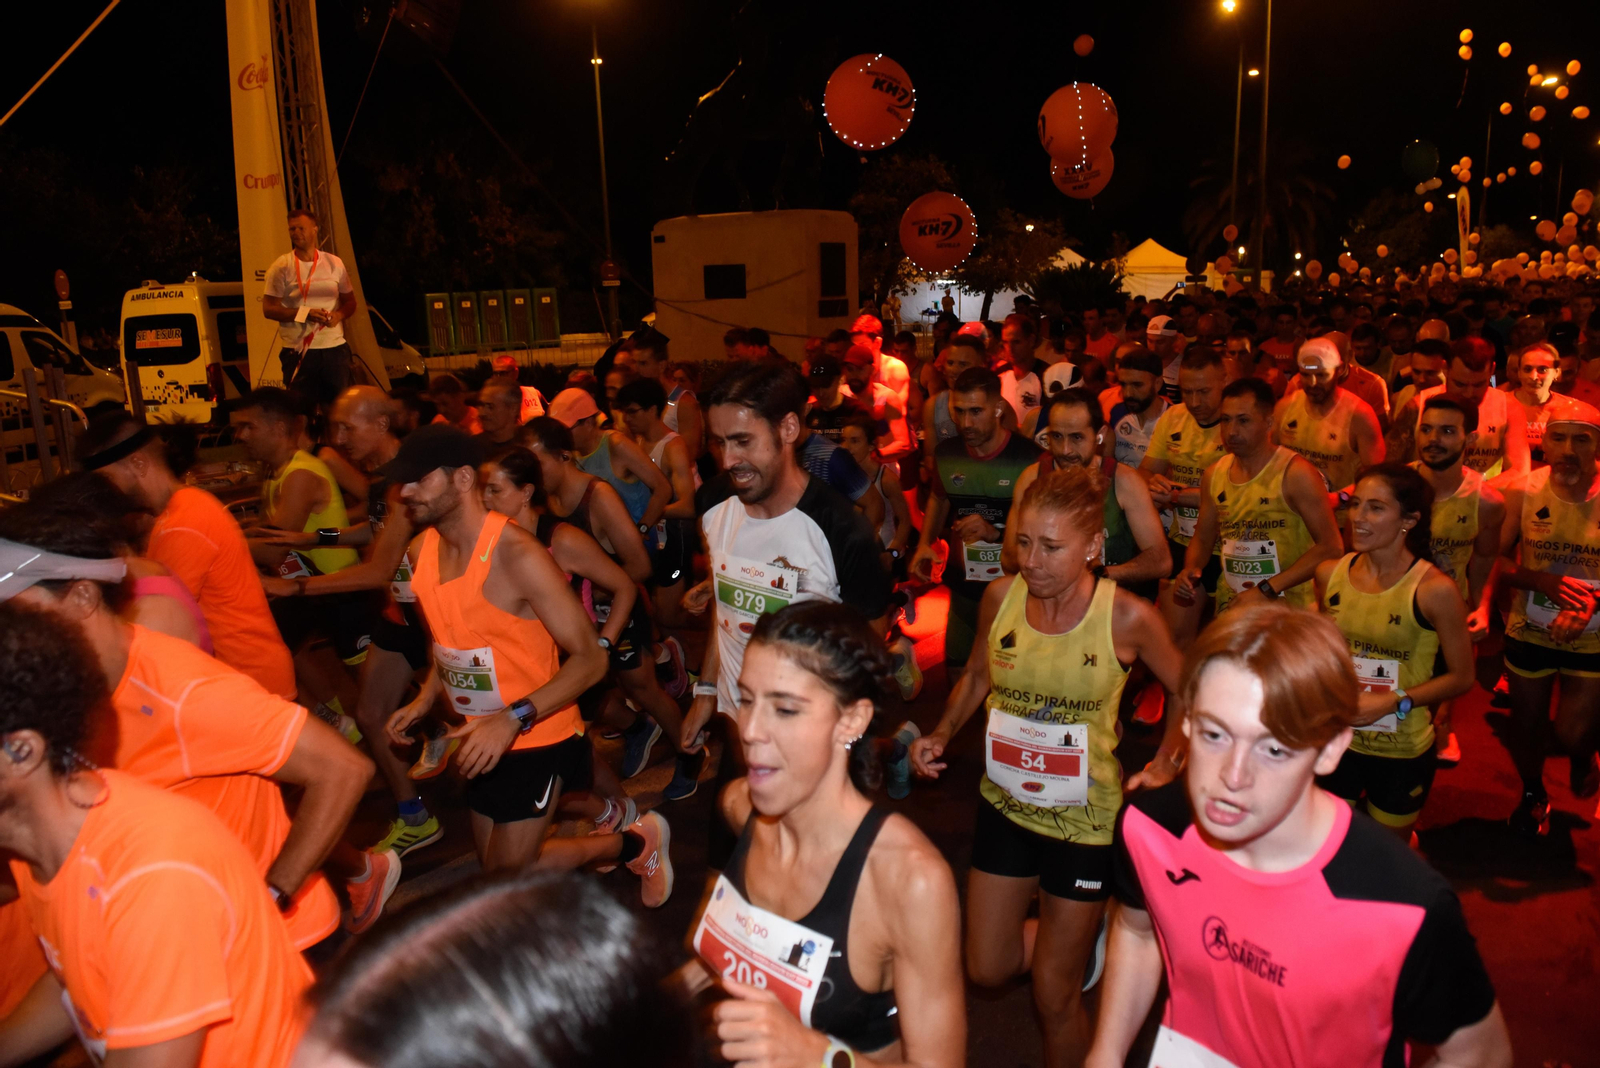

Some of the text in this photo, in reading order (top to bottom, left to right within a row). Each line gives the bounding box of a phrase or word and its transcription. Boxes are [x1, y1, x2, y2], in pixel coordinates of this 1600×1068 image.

[130, 290, 184, 302] AMBULANCIA
[135, 328, 182, 341] SEMESUR
[1232, 560, 1263, 574] 5023
[733, 589, 766, 614] 979
[1354, 640, 1411, 661] PIRÁMIDE
[1034, 693, 1103, 712] PIRÁMIDE
[1001, 700, 1080, 725] MIRAFLORES
[1020, 750, 1047, 772] 54
[1074, 878, 1103, 890] PUMA
